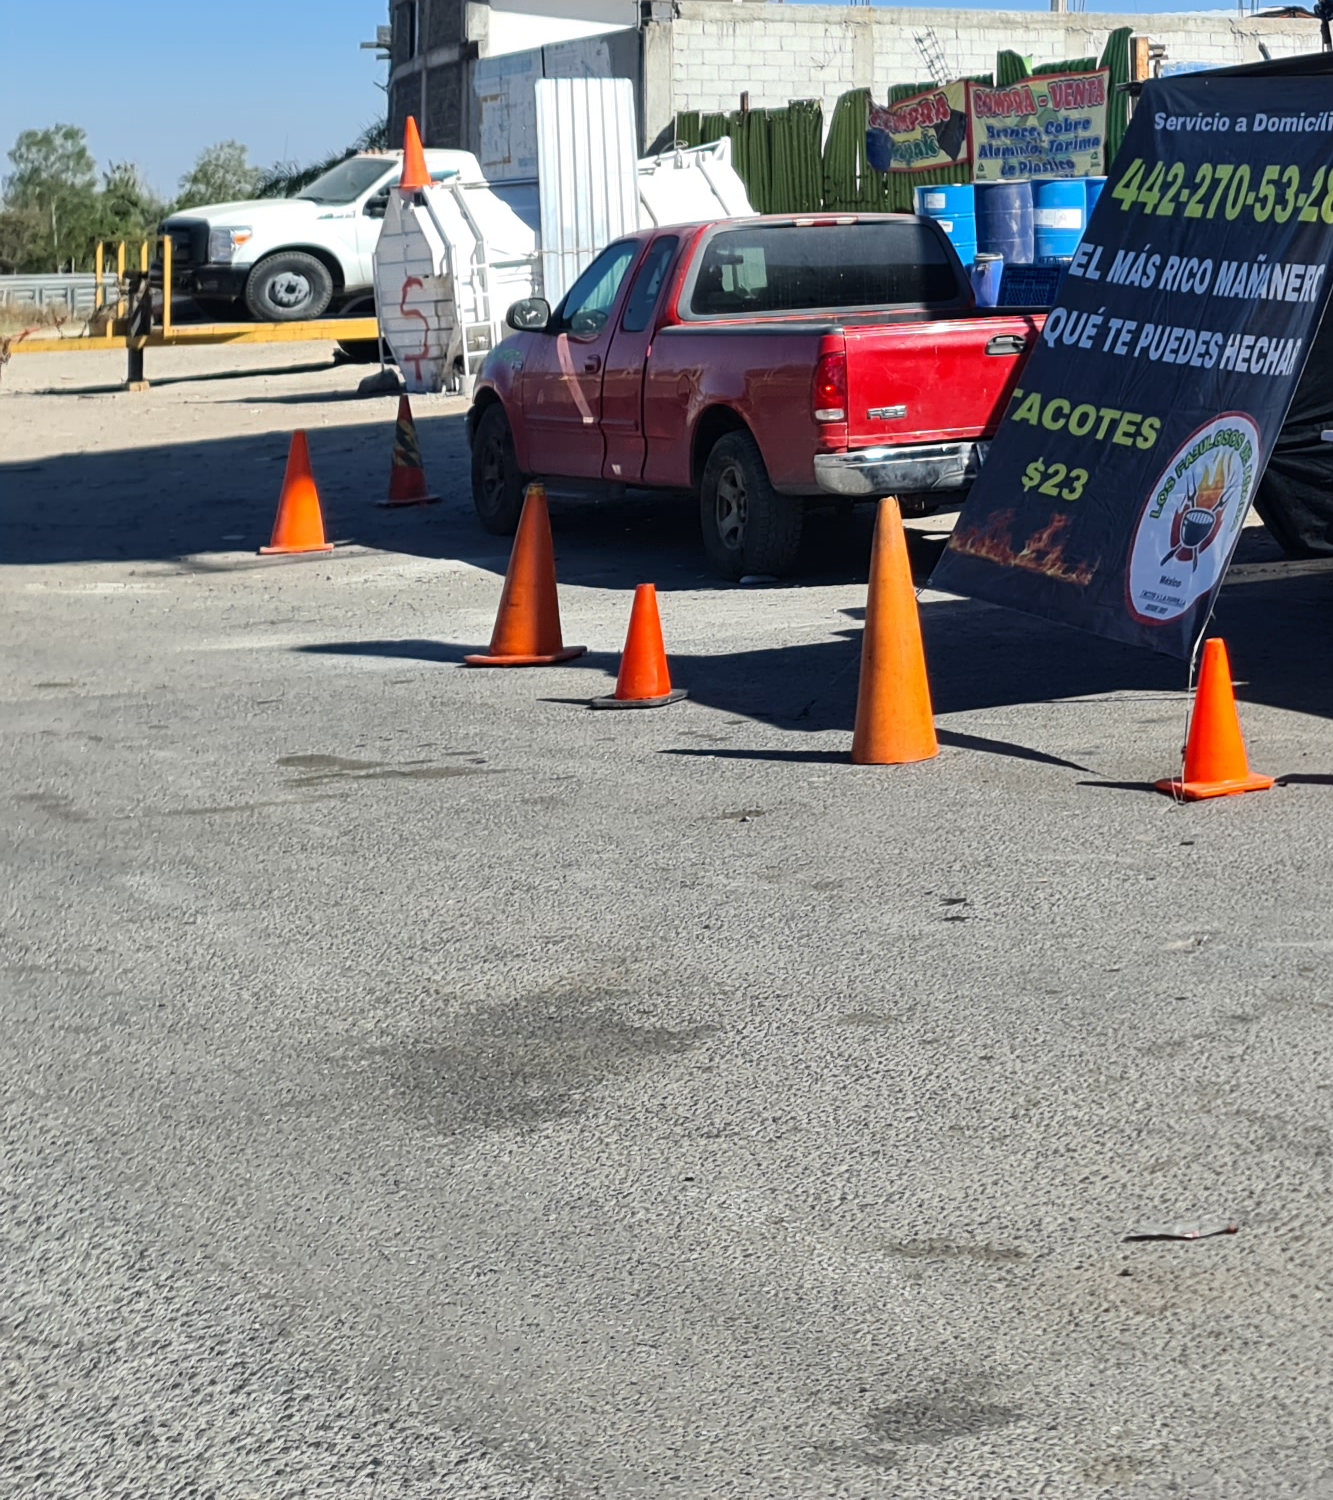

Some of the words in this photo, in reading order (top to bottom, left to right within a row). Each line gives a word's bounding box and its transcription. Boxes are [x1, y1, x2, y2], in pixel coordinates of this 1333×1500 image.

[973, 84, 1038, 119] COMPRA
[1049, 76, 1106, 112] VENTA
[1044, 116, 1092, 136] Cobre
[1154, 112, 1230, 131] Servicio
[1235, 117, 1248, 132] a
[1068, 242, 1104, 280] EL
[1106, 243, 1161, 288] MÁS
[1158, 255, 1213, 295] RICO
[1043, 306, 1106, 349] QUÉ
[1102, 317, 1138, 355] TE
[1134, 323, 1224, 370] PUEDES
[1021, 456, 1089, 501] $23
[1150, 476, 1176, 519] LOS
